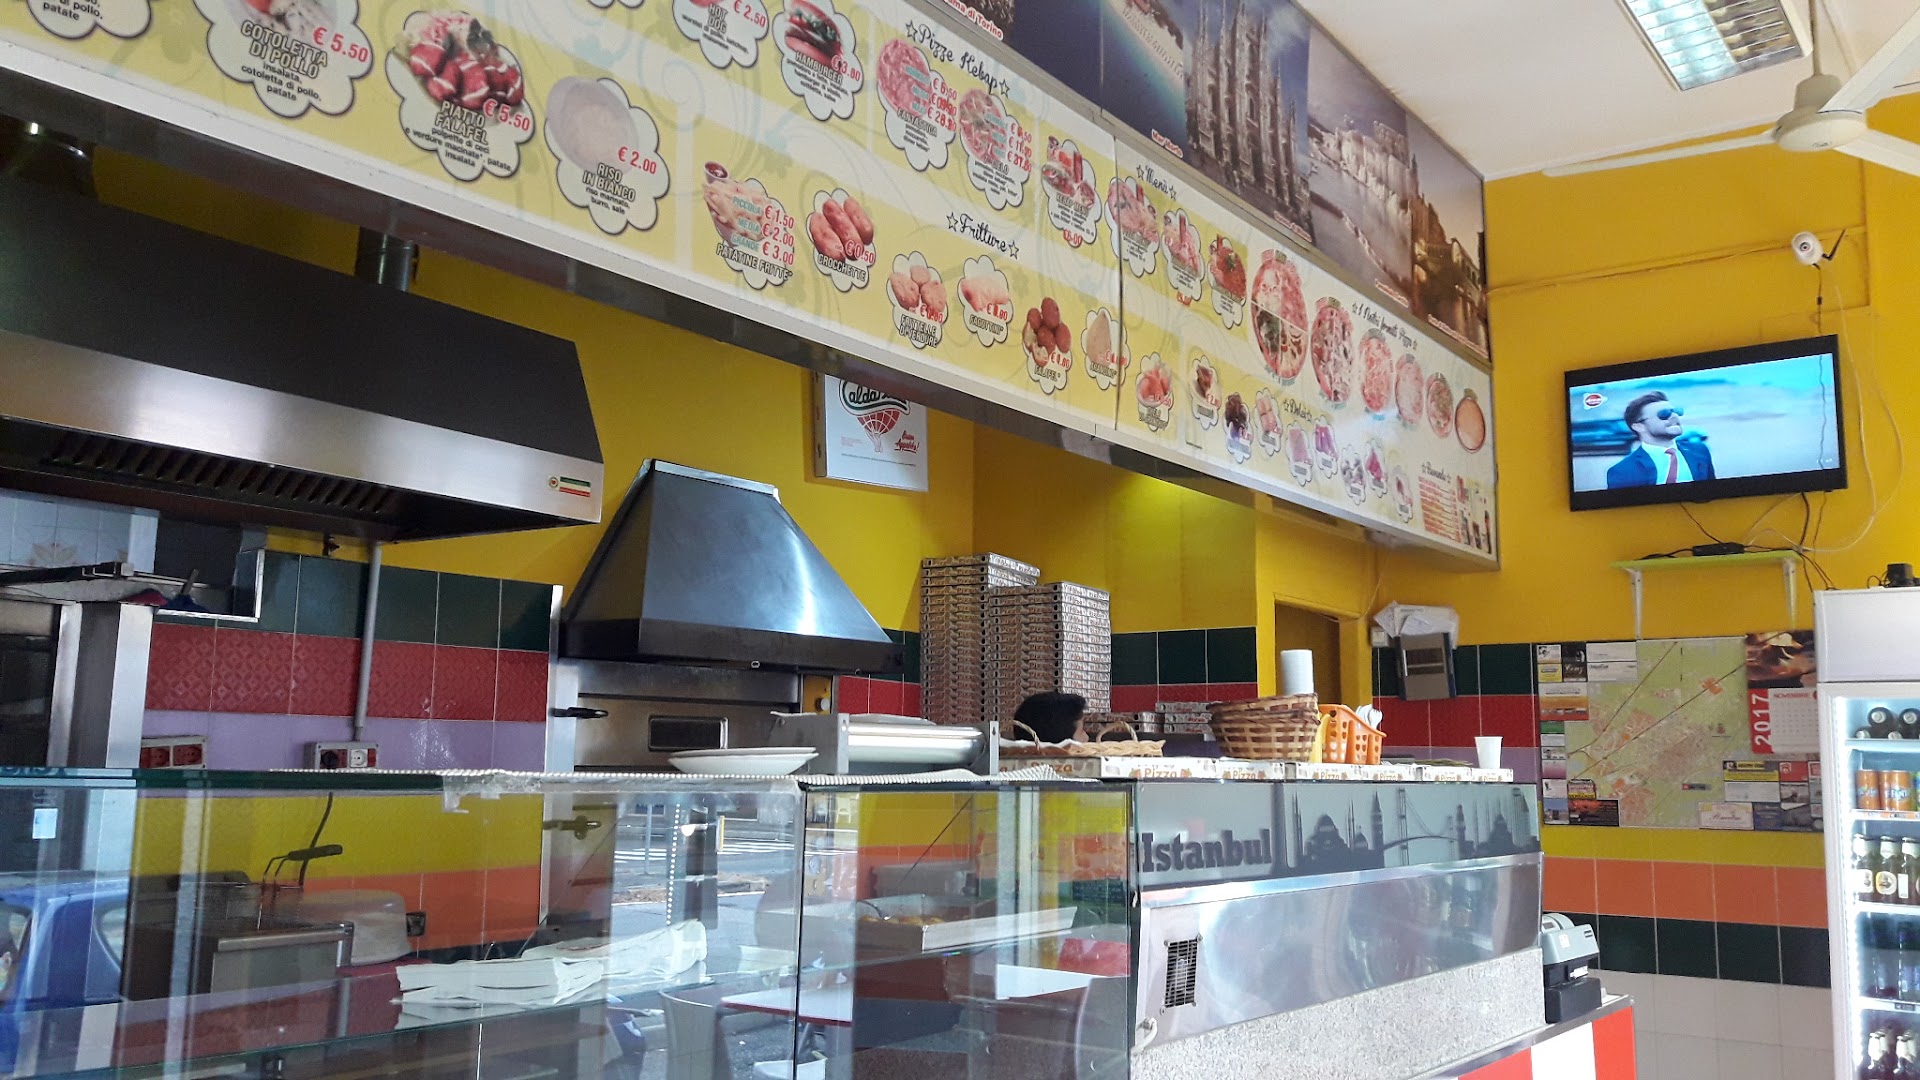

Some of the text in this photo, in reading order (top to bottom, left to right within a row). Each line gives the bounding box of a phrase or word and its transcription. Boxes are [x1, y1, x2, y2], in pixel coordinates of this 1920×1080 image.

[43, 2, 80, 20] patate
[708, 2, 728, 20] HOT
[743, 4, 767, 28] 2.50
[966, 6, 977, 22] di
[977, 11, 1002, 38] Torino
[708, 15, 727, 34] DOG
[241, 20, 328, 67] COTOLETTA
[330, 33, 370, 63] 5.50
[249, 40, 320, 79] DI POLLO
[795, 52, 843, 86] HAMBURGER
[919, 24, 955, 62] Pizze
[960, 51, 998, 95] Kebap
[241, 65, 284, 87] cotoletta
[266, 84, 297, 101] patate
[441, 100, 485, 128] PIATTO
[499, 104, 531, 131] 5.50
[435, 113, 488, 146] FALAFEL
[597, 162, 622, 183] RISO
[630, 151, 657, 174] 2.00
[582, 170, 637, 202] IN BIANCO
[774, 209, 794, 229] 1.50
[772, 226, 794, 247] 2.00
[960, 213, 1007, 252] Fritture
[716, 243, 758, 269] PATATINE
[772, 245, 794, 266] 3.00
[817, 253, 867, 282] CROCCHETTE
[1752, 692, 1771, 748] 2017
[1144, 767, 1178, 779] Pizza
[1232, 769, 1256, 780] Pizza
[1141, 828, 1272, 873] Istanbul
